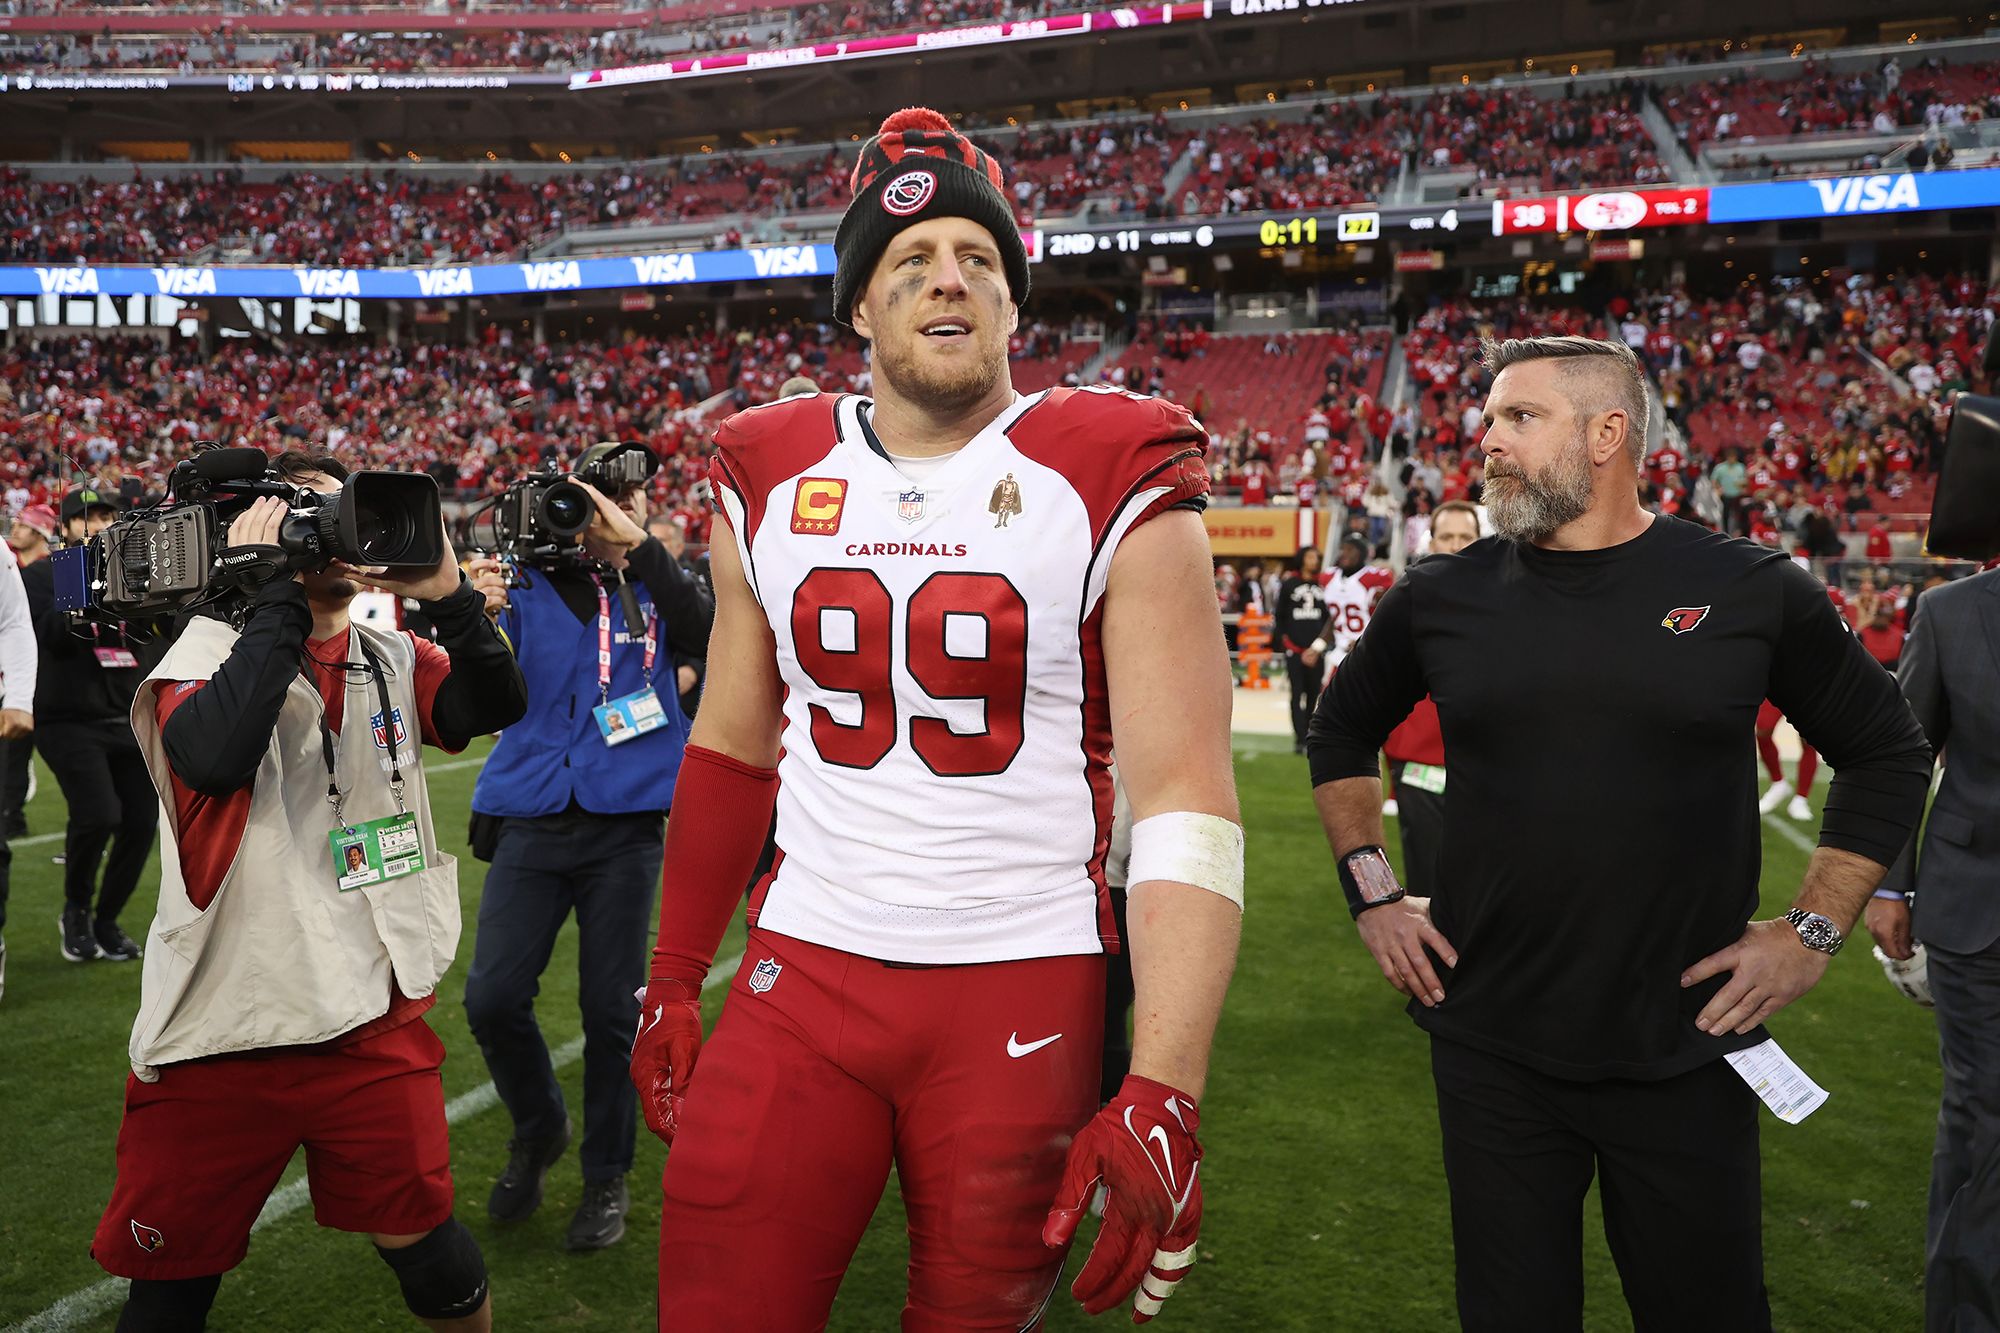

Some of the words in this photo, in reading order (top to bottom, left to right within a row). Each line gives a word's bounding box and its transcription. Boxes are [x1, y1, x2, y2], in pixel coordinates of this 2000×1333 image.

[837, 43, 847, 56] 7
[1683, 198, 1698, 215] 2
[1808, 173, 1920, 213] VISA
[1439, 208, 1459, 232] 4
[1512, 204, 1546, 228] 38
[1050, 233, 1096, 256] 2ND
[1116, 230, 1140, 252] 11
[1195, 225, 1214, 247] 6
[1260, 216, 1318, 246] 0:11
[631, 253, 697, 284] VISA
[748, 245, 819, 277] VISA
[34, 267, 100, 293] VISA
[151, 268, 217, 294] VISA
[293, 269, 361, 296] VISA
[413, 268, 474, 296] VISA
[519, 261, 582, 290] VISA
[796, 481, 842, 520] C
[900, 501, 921, 517] NFL
[149, 532, 159, 580] AMIRA
[224, 551, 258, 565] FUJINON
[845, 542, 968, 557] CARDINALS
[1327, 603, 1364, 633] 26
[790, 566, 1028, 777] 99
[375, 723, 404, 746] NL
